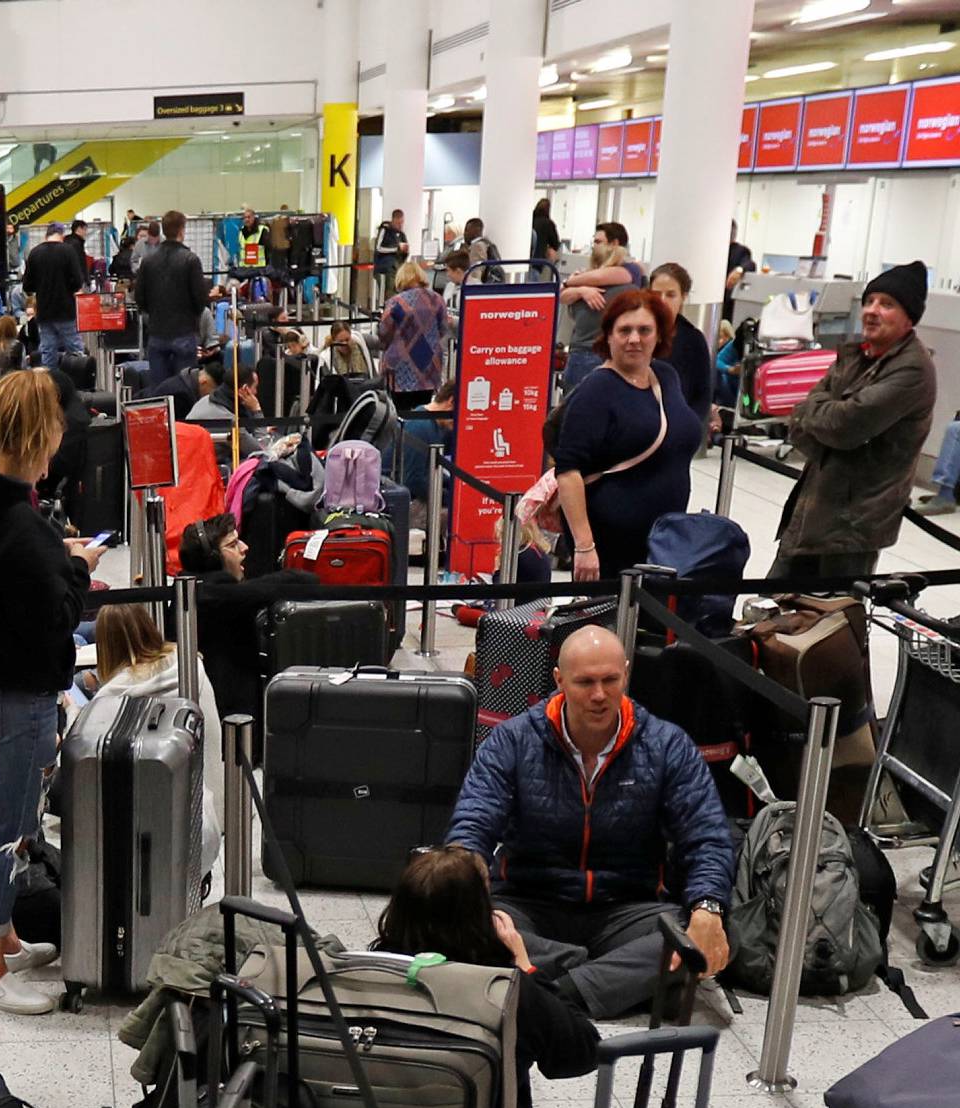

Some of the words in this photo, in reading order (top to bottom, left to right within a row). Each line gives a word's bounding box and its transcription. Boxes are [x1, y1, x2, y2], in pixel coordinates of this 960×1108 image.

[190, 105, 218, 114] baggage
[329, 154, 351, 188] K
[8, 184, 65, 225] Departures
[480, 310, 538, 320] norwegian
[469, 345, 494, 355] Carry
[507, 344, 542, 354] baggage
[485, 357, 528, 366] allowance
